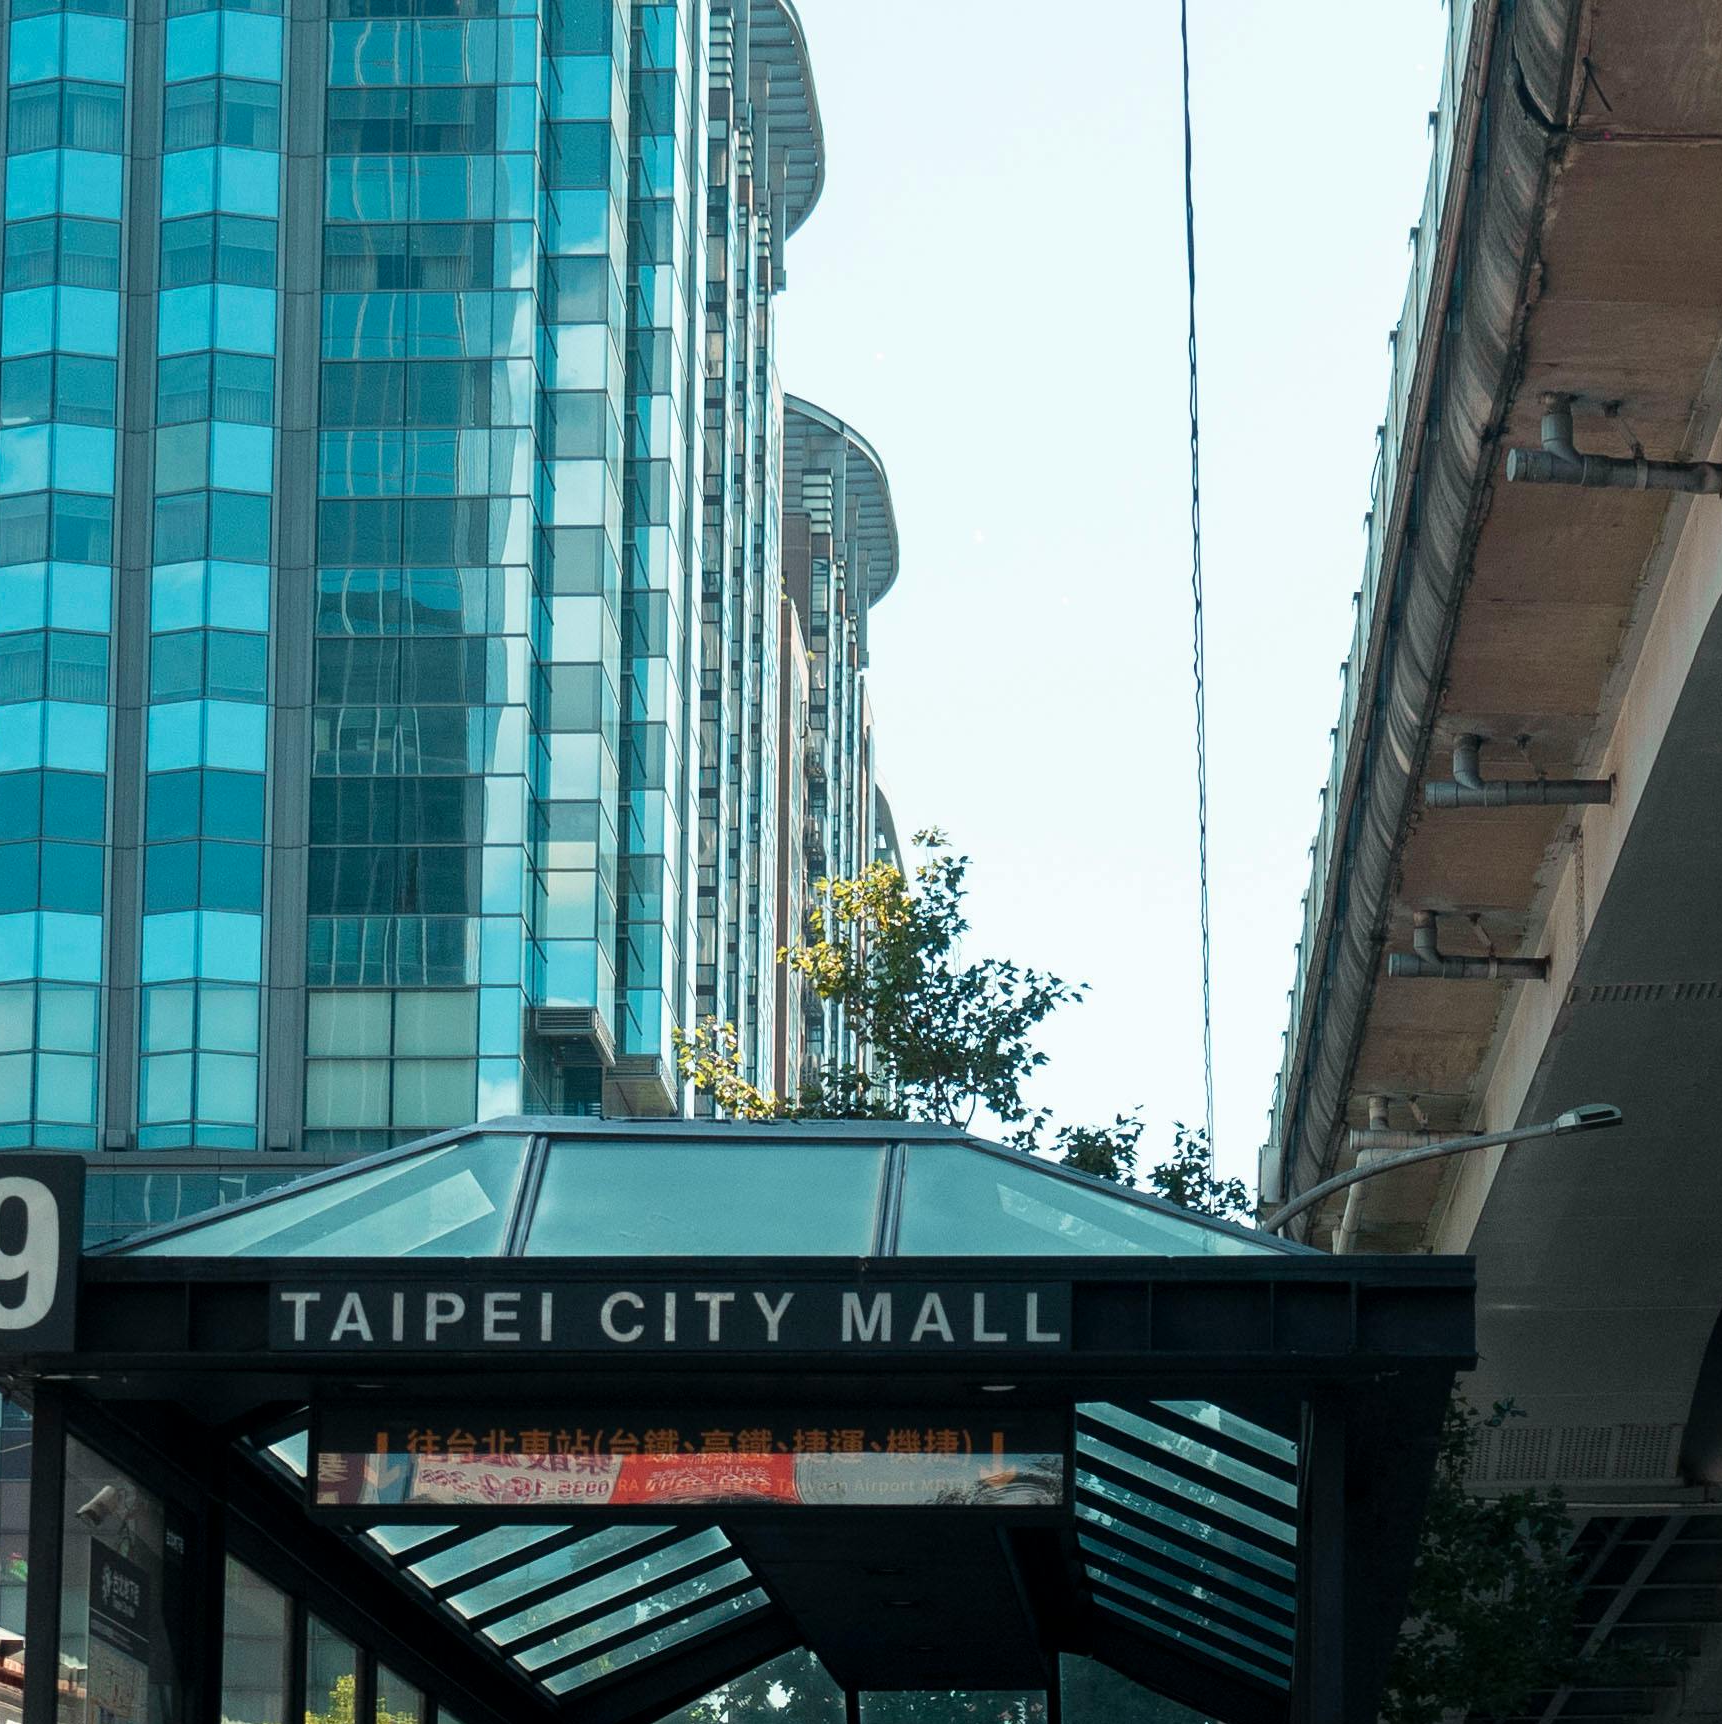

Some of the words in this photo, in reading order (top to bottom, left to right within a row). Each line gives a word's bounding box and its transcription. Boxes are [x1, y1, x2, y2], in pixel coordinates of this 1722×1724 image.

[280, 1290, 553, 1344] TAIPEI
[599, 1290, 796, 1344] CITY
[840, 1291, 1062, 1344] MALL
